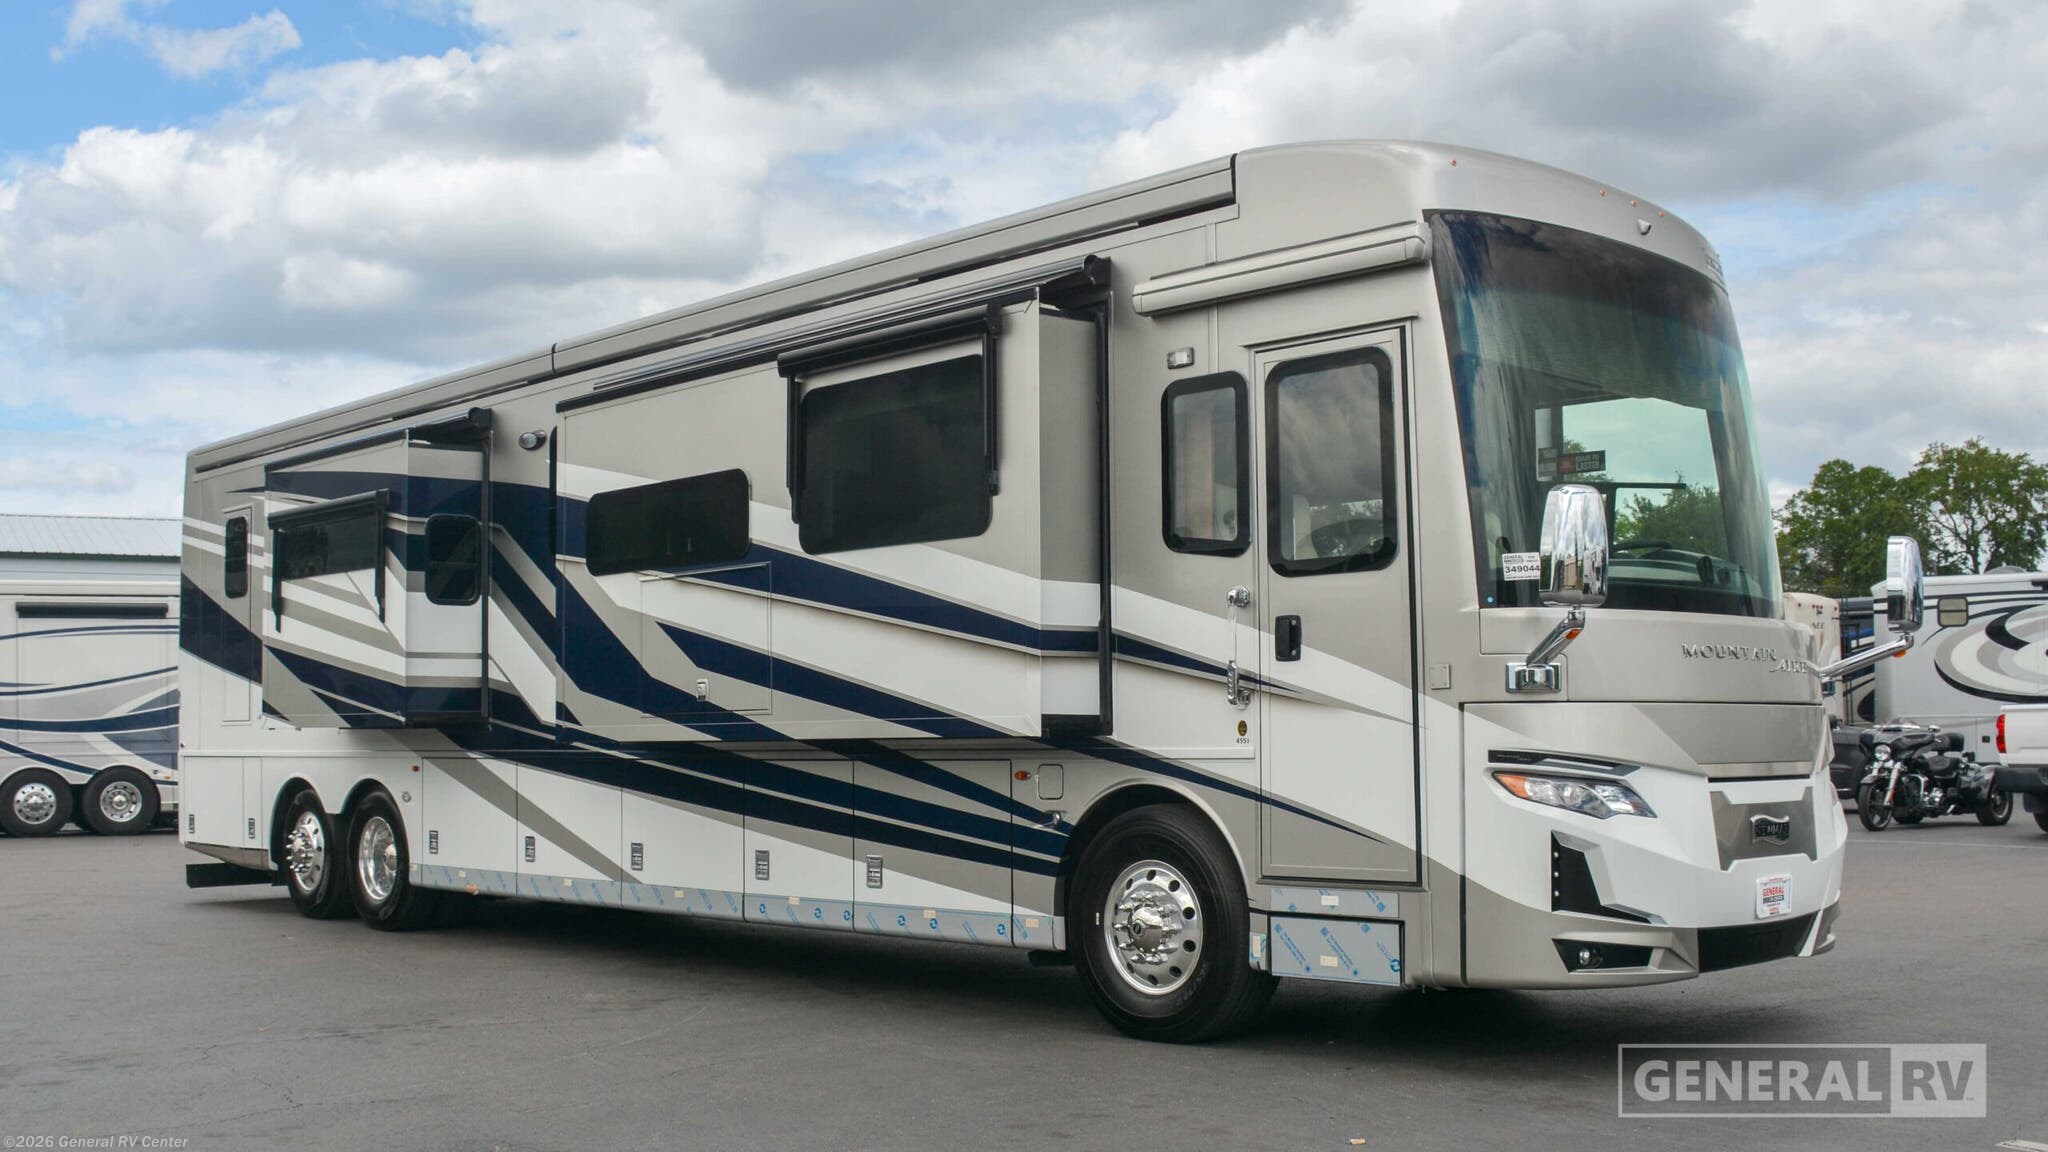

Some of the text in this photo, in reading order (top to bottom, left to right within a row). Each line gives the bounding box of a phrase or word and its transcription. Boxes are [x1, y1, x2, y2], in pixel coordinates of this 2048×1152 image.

[1504, 564, 1541, 574] 349044
[1681, 643, 1777, 662] MOUNTAIN
[1762, 886, 1784, 897] GENERAL
